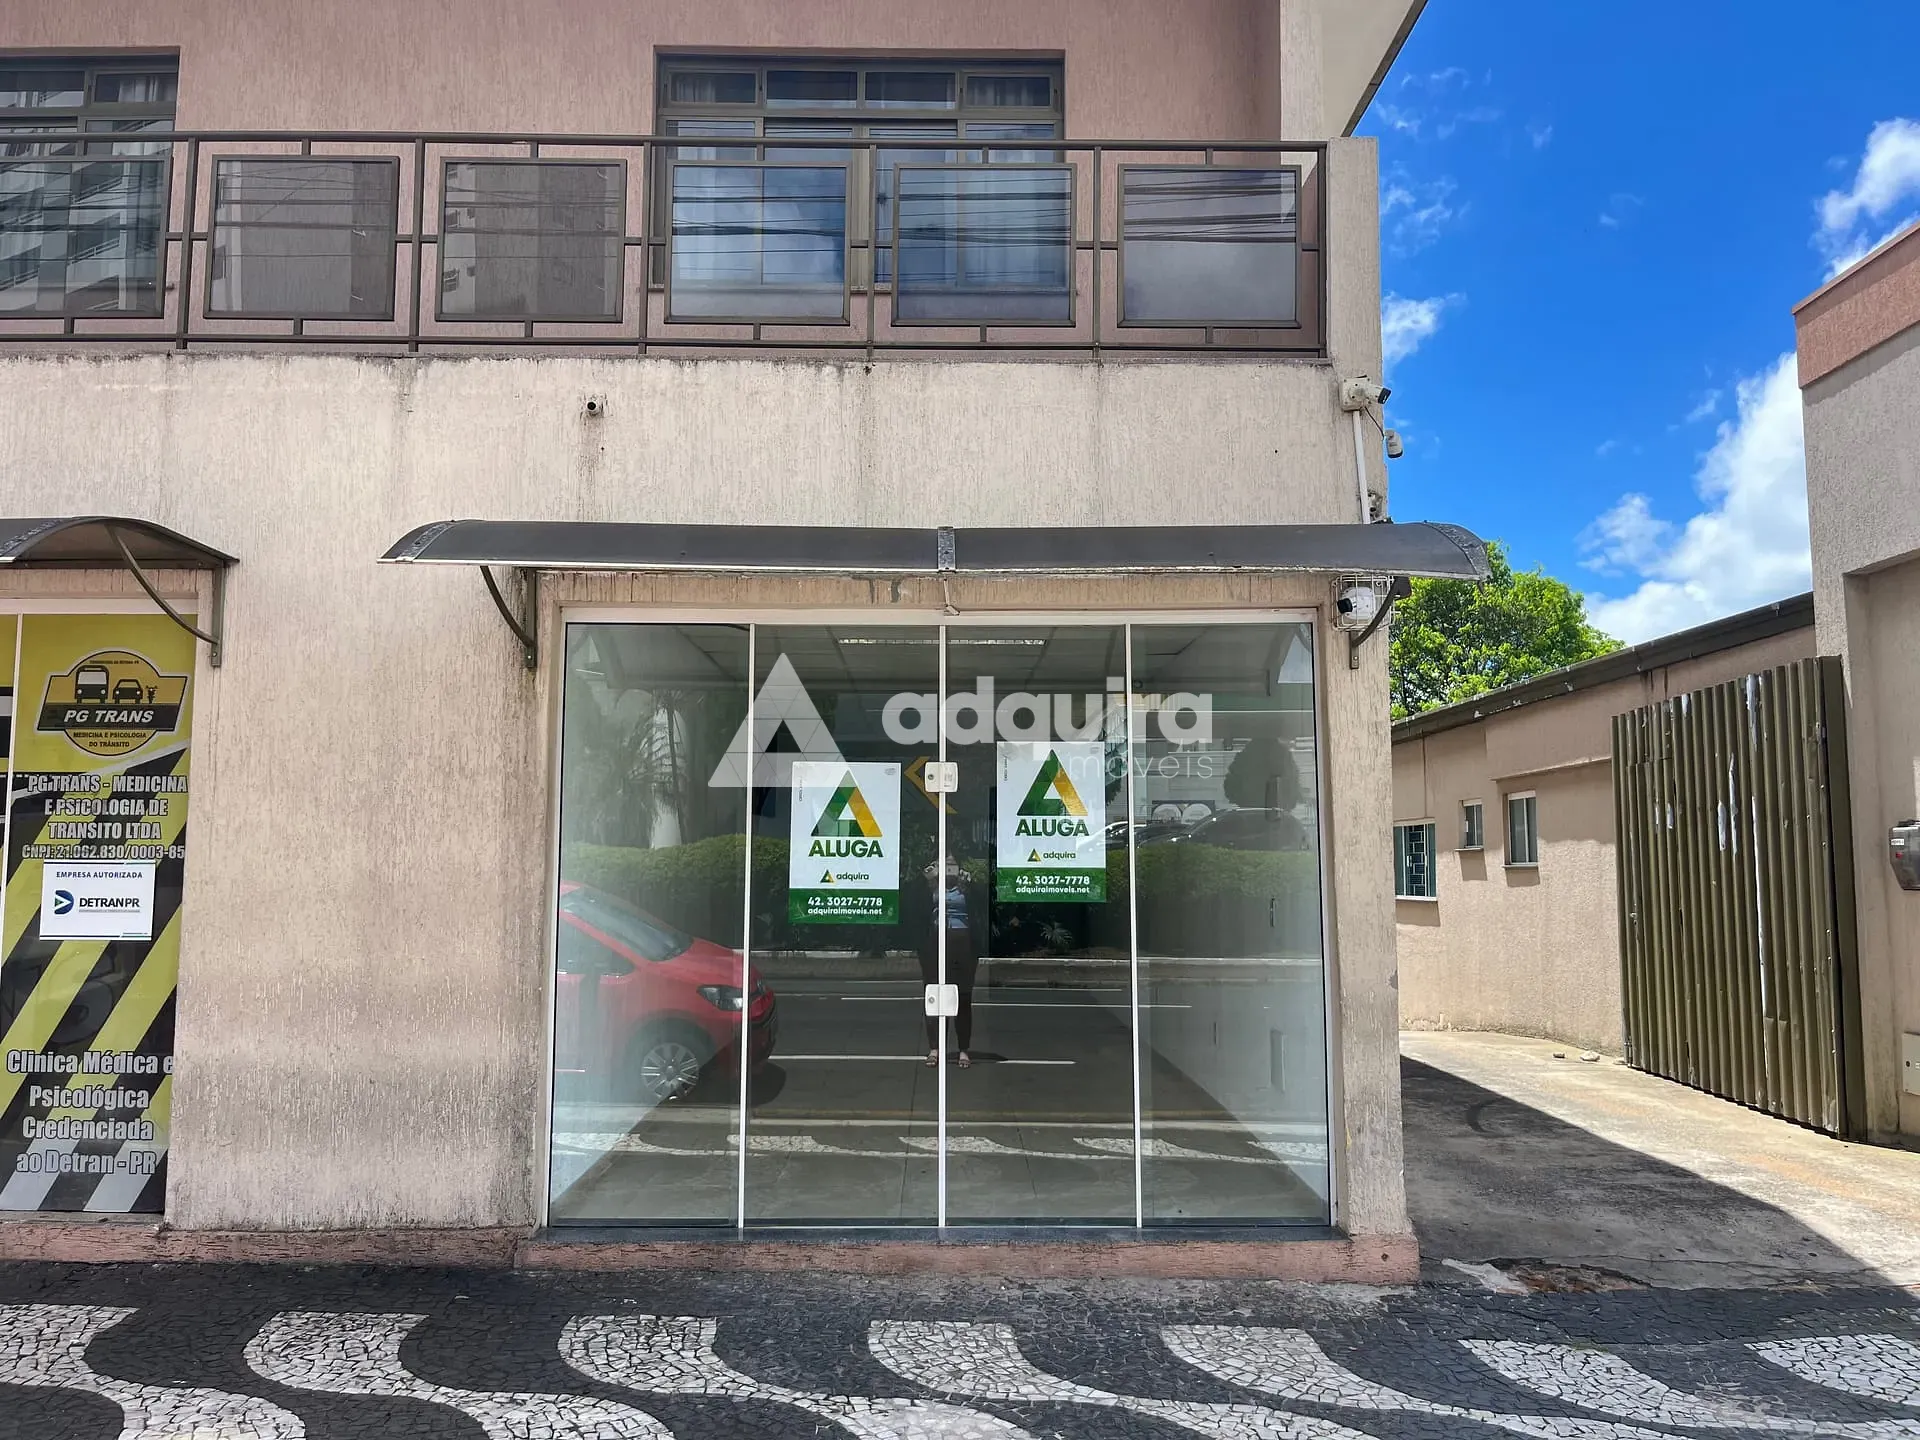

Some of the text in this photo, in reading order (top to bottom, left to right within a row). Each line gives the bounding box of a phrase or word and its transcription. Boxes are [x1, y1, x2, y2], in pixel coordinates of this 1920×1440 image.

[64, 710, 154, 723] PG TRANS
[113, 776, 187, 792] MEDICINA
[45, 799, 168, 816] E PSICOLOGIA DE
[49, 822, 161, 839] TRANSITO LTDA
[1015, 818, 1089, 837] ALUGA
[808, 839, 884, 858] ALUGA
[1043, 850, 1076, 861] adquira
[836, 871, 869, 882] adquira
[1015, 875, 1090, 886] 42. 3027-7778
[1015, 886, 1090, 895] adquiraimoveis.net
[807, 896, 883, 906] 42. 3027-7778
[807, 907, 883, 916] adquiraimoveis.net
[82, 1051, 158, 1073] Médica
[29, 1085, 149, 1110] Psicológica
[22, 1116, 153, 1140] Credenciada
[16, 1153, 42, 1173] ao
[45, 1150, 114, 1173] Detran
[129, 1152, 156, 1174] PR
